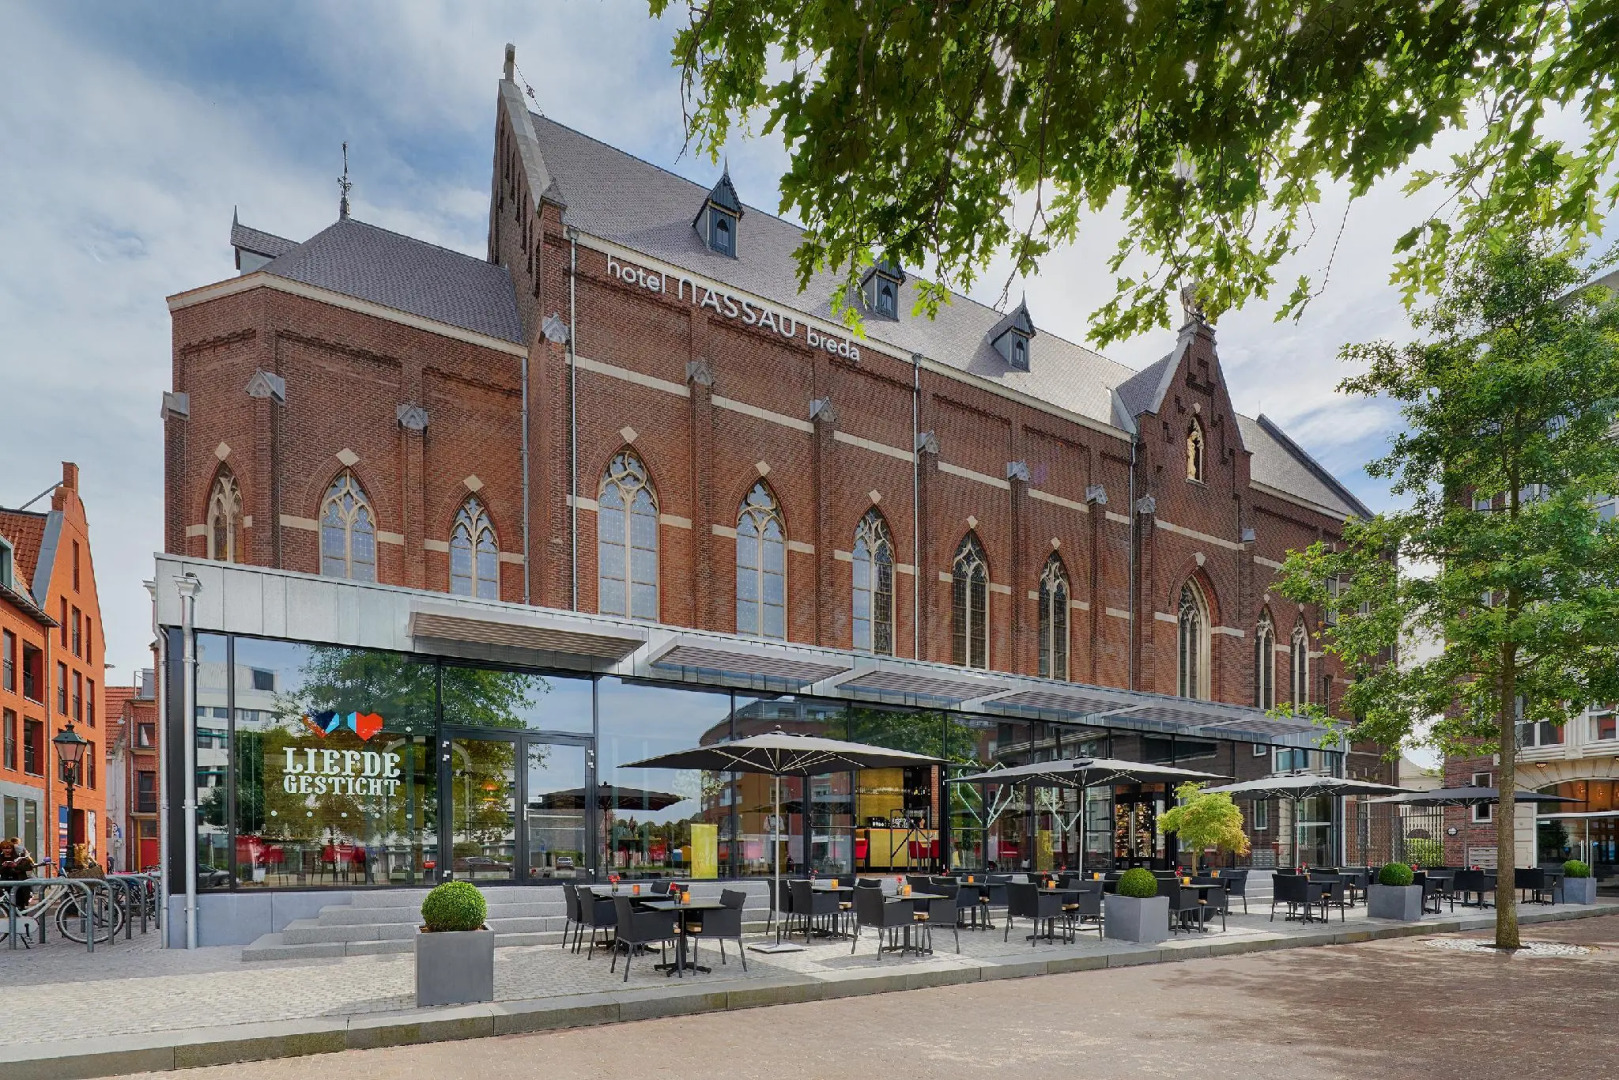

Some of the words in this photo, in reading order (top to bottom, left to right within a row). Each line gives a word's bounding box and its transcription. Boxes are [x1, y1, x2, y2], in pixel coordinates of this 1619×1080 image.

[607, 253, 666, 294] hotel
[806, 325, 860, 362] breda
[282, 747, 401, 778] LIEFDE
[283, 775, 401, 797] GESTICHT
